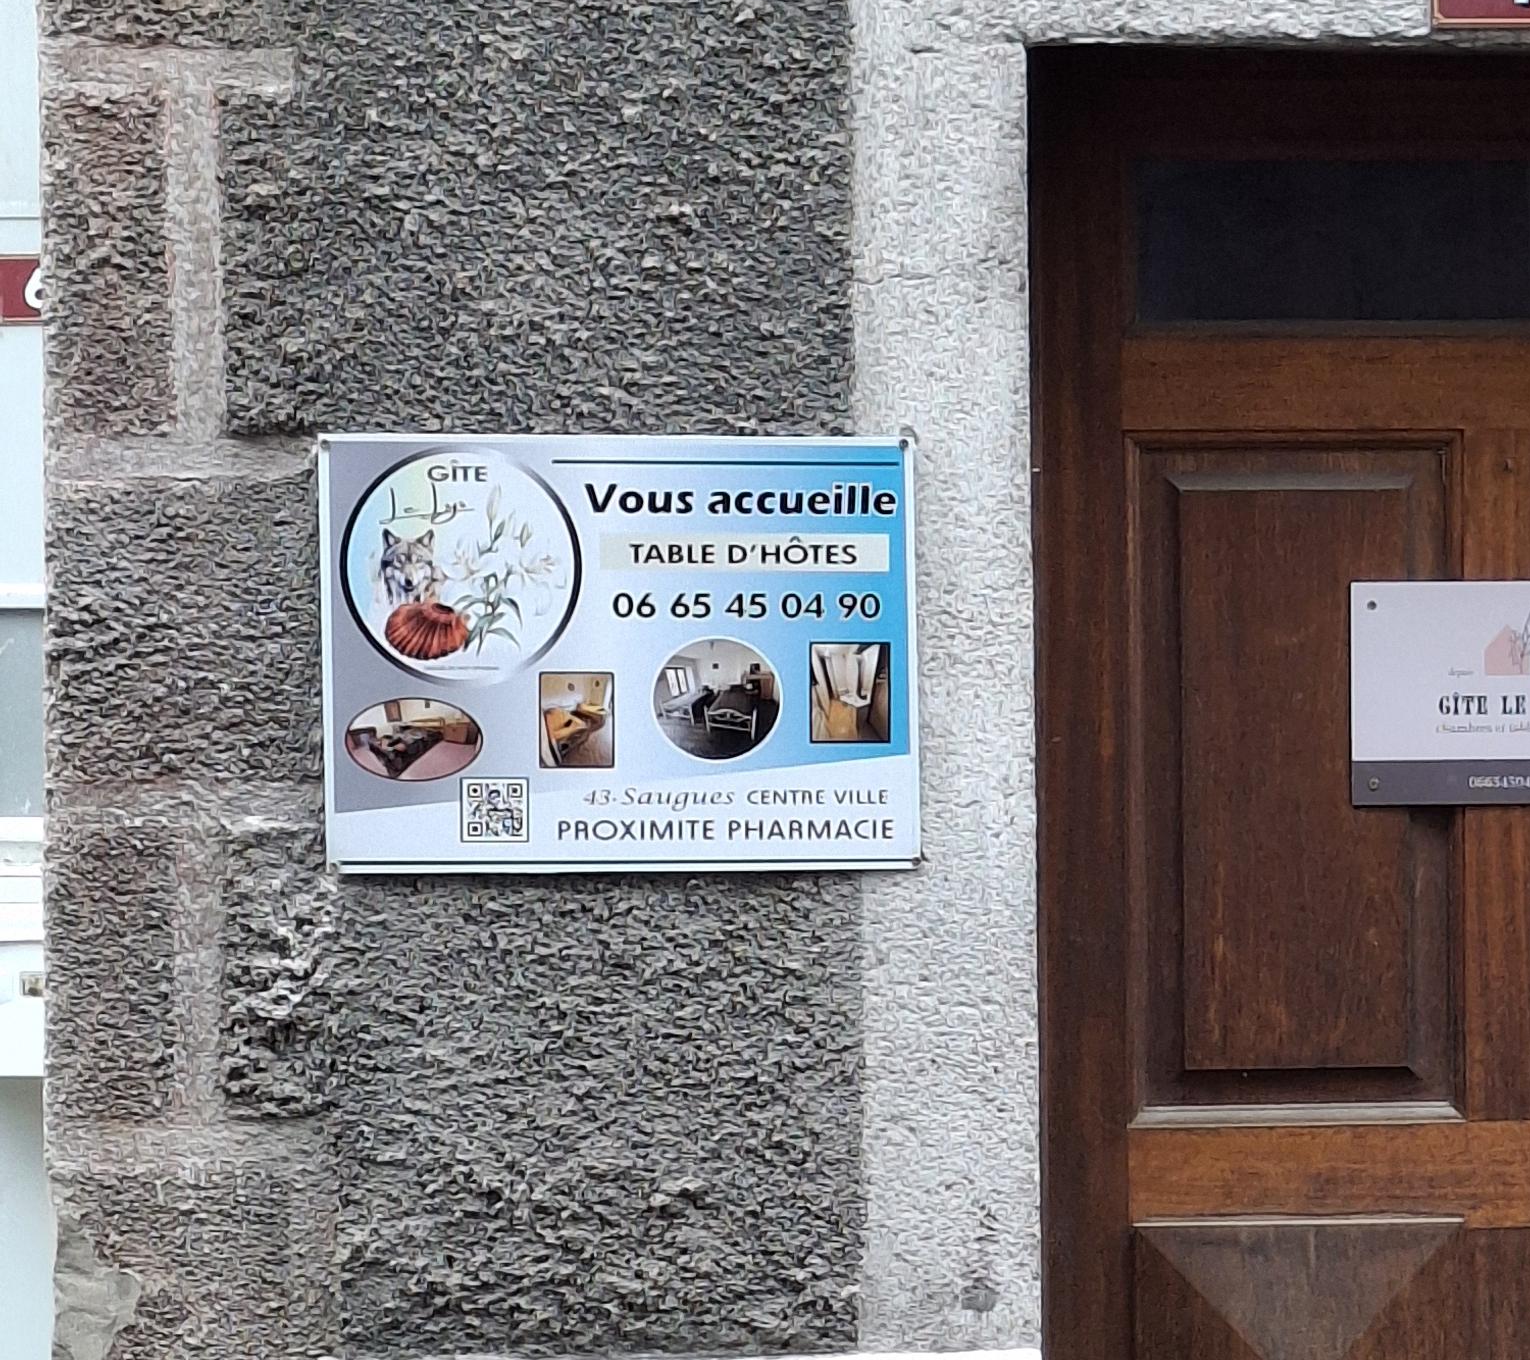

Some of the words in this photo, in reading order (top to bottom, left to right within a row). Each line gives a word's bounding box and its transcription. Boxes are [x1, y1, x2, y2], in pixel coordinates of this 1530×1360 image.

[426, 459, 488, 483] GÎTE
[584, 483, 694, 514] Vous
[707, 484, 897, 515] accueille
[629, 543, 716, 564] TABLE
[727, 536, 858, 565] D'HÔTES
[612, 592, 656, 619] 06
[670, 592, 712, 619] 65
[724, 592, 768, 619] 45
[781, 592, 825, 619] 04
[838, 592, 881, 619] 90
[1438, 691, 1489, 716] GÎTE
[1500, 694, 1526, 715] LE
[746, 789, 826, 806] CENTRE
[833, 789, 889, 805] VILLE
[557, 819, 716, 841] PROXIMITE
[727, 819, 895, 840] PHARMACIE
